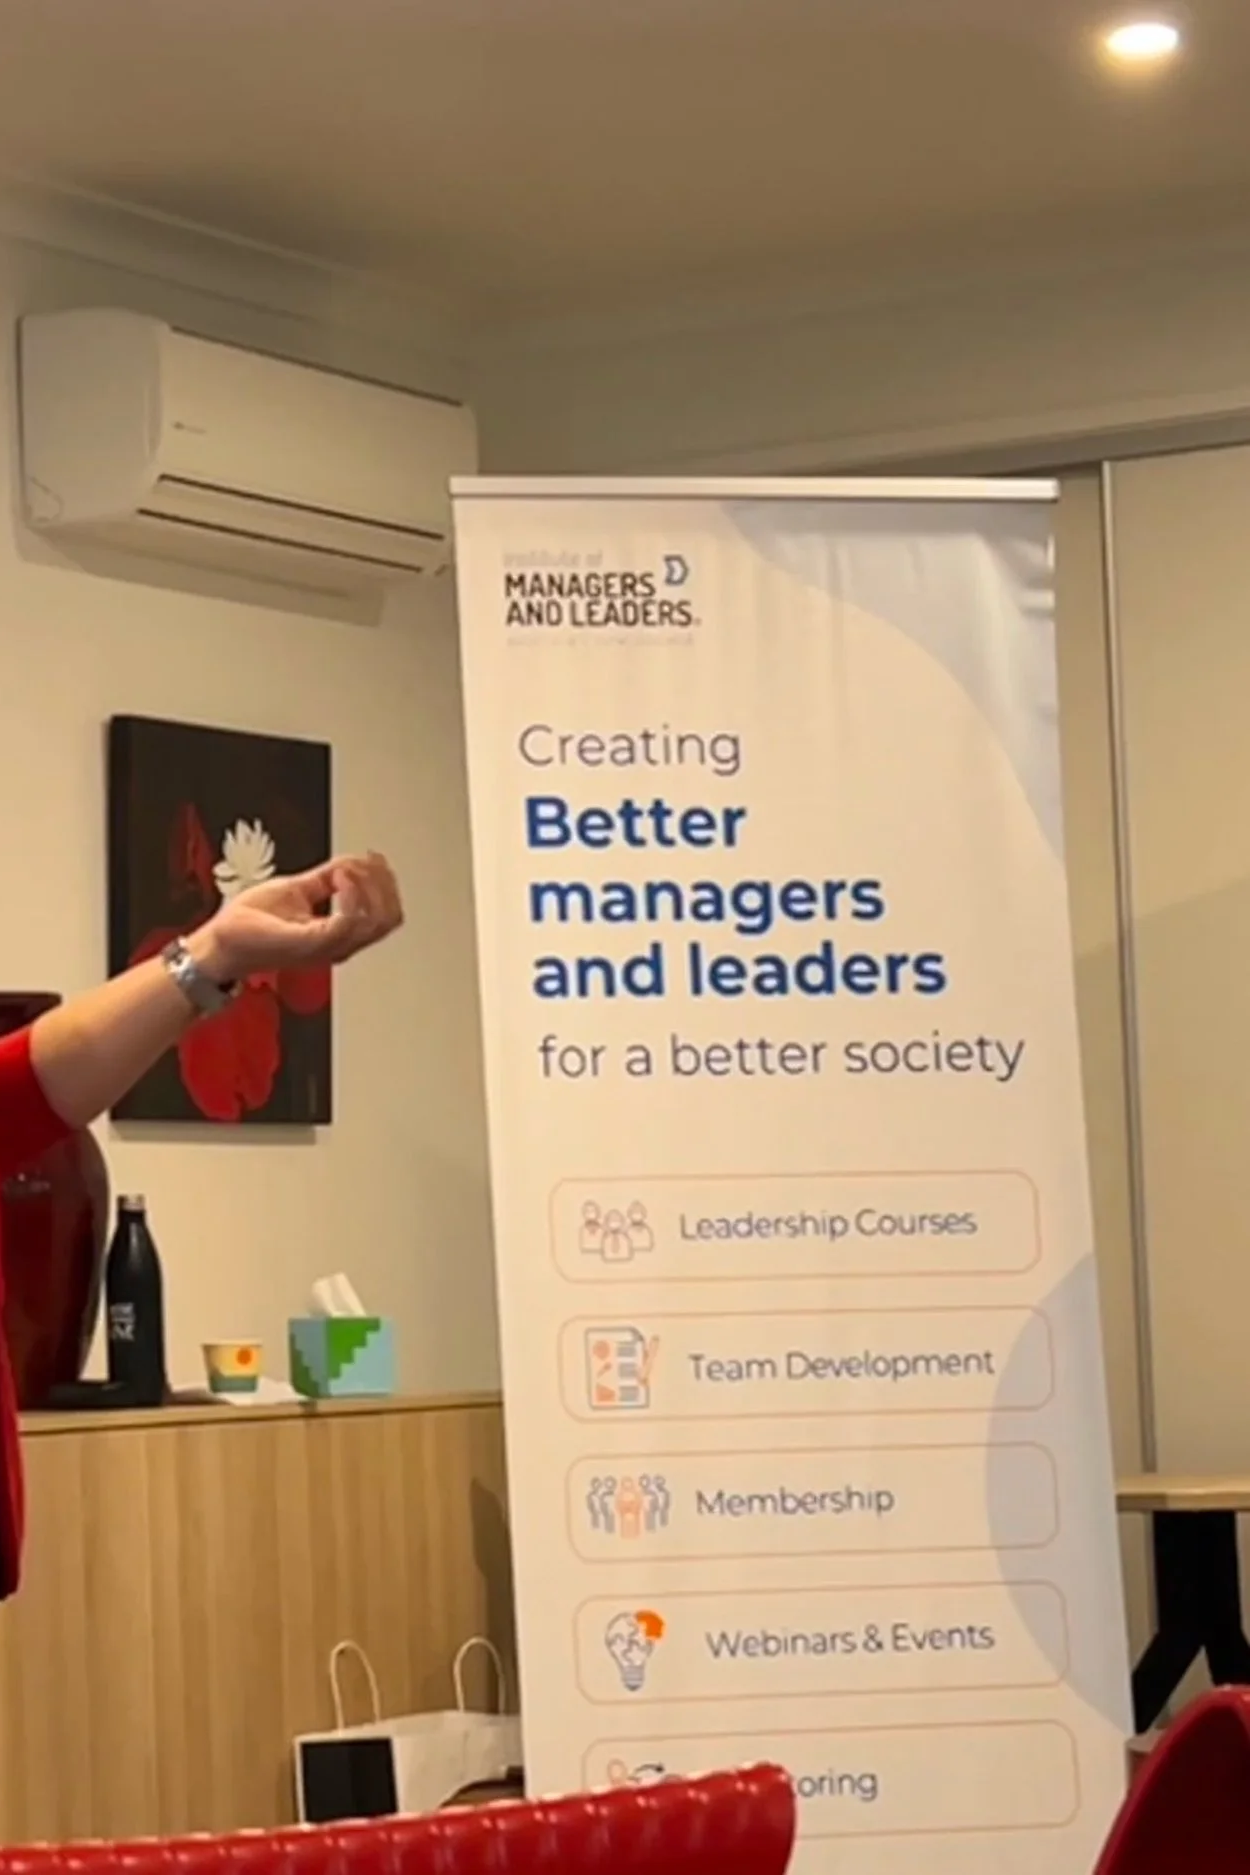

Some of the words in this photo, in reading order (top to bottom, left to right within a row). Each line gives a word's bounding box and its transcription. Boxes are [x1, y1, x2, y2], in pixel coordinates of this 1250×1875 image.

[505, 572, 656, 600] MANAGERS
[506, 599, 562, 626] AND
[519, 724, 740, 776] Creating
[526, 796, 746, 848] Better
[530, 880, 884, 935] managers
[533, 941, 664, 998] and
[689, 940, 946, 996] leaders
[538, 1034, 606, 1078] for
[626, 1045, 652, 1077] a
[671, 1033, 827, 1076] better
[844, 1030, 1025, 1082] society
[680, 1212, 849, 1241] Leadership
[855, 1209, 977, 1236] Courses
[688, 1354, 777, 1381] Team
[786, 1350, 995, 1382] Development
[696, 1486, 894, 1516] Membership
[706, 1630, 857, 1658] Webinars
[862, 1624, 884, 1653] &
[891, 1623, 995, 1652] Events
[797, 1767, 878, 1803] oring
